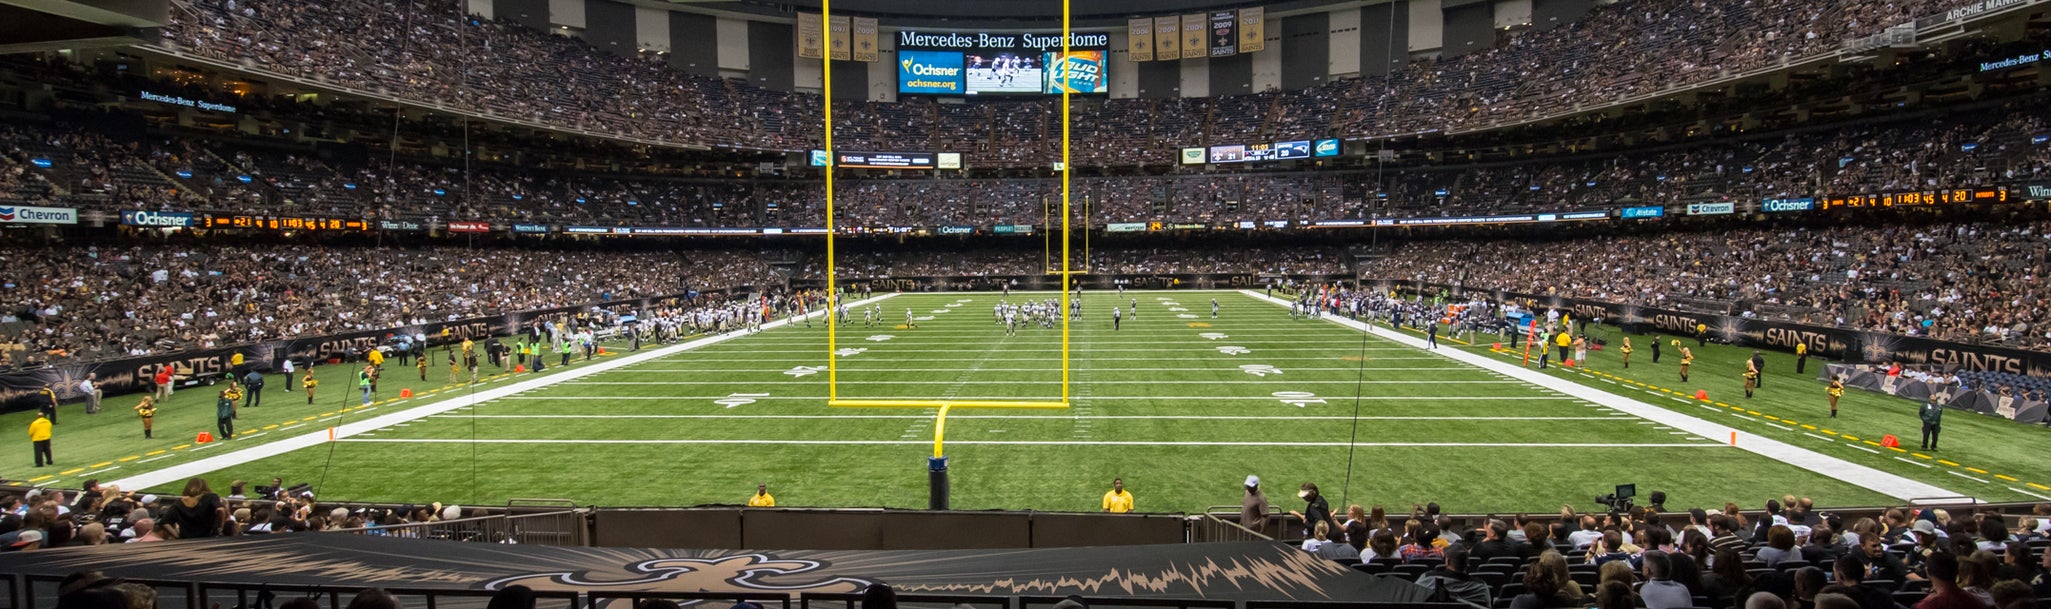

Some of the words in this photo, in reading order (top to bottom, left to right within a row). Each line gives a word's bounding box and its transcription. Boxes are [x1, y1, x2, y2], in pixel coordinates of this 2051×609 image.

[1945, 2, 1984, 21] ARCHIE
[1213, 21, 1232, 29] 2009
[901, 32, 1015, 49] Mercedes-Benz
[1023, 33, 1107, 50] Superdome
[193, 47, 228, 61] SAINTS
[1060, 62, 1099, 74] BUD
[1980, 53, 2040, 72] Mercedes-Benz
[270, 63, 300, 76] SAINTS
[913, 64, 958, 76] Ochsner
[907, 80, 957, 90] ochsner.org
[141, 91, 195, 107] Mercedes-Benz
[198, 100, 237, 113] Superdome
[1228, 152, 1236, 160] 21
[1280, 149, 1290, 157] 20
[1853, 197, 1865, 206] 21
[1923, 194, 1935, 204] 45
[1942, 194, 1949, 203] 4
[1954, 191, 1966, 201] 20
[2000, 190, 2007, 201] 3
[1769, 199, 1809, 212] Ochsner
[1869, 198, 1876, 207] 4
[1883, 197, 1892, 207] 10
[20, 208, 69, 221] Chevron
[1702, 205, 1729, 214] Chevron
[135, 210, 188, 226] Ochsner
[330, 219, 341, 229] 20
[942, 226, 972, 234] Ochsner
[872, 278, 914, 289] SAINTS
[1232, 276, 1252, 287] SAI
[1575, 304, 1607, 319] SAINTS
[1655, 314, 1697, 334] SAINTS
[448, 322, 487, 341] SAINTS
[1766, 328, 1827, 351] SAINTS
[320, 337, 377, 359] SAINTS
[1931, 349, 2021, 375] SAINTS
